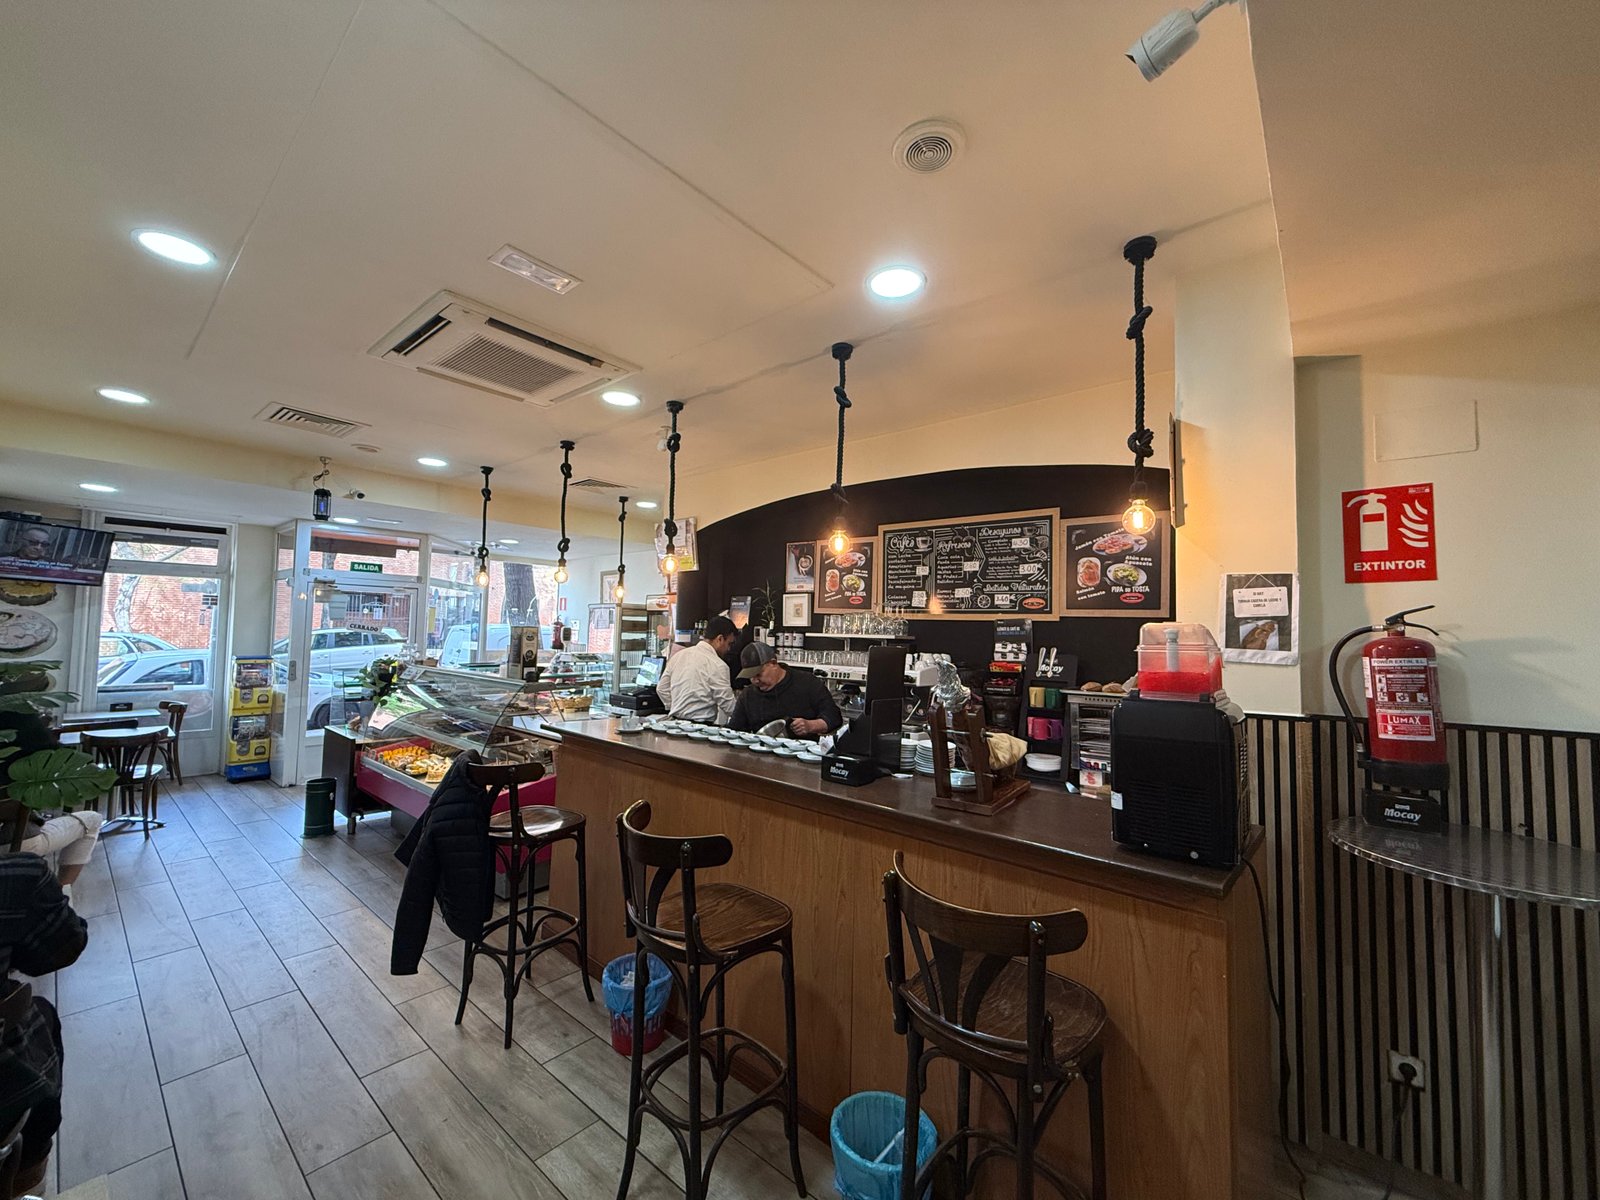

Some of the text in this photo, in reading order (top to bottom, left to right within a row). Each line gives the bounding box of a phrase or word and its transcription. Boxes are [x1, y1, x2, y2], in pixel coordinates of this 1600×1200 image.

[979, 528, 1021, 538] Desayunos
[936, 540, 971, 552] Refrescos
[354, 564, 379, 572] SALIDA
[1354, 560, 1426, 572] EXTINTOR
[350, 623, 379, 632] CERRADO
[1387, 714, 1421, 725] LUMAX
[830, 766, 849, 777] Mocay
[1384, 808, 1421, 822] Mocay
